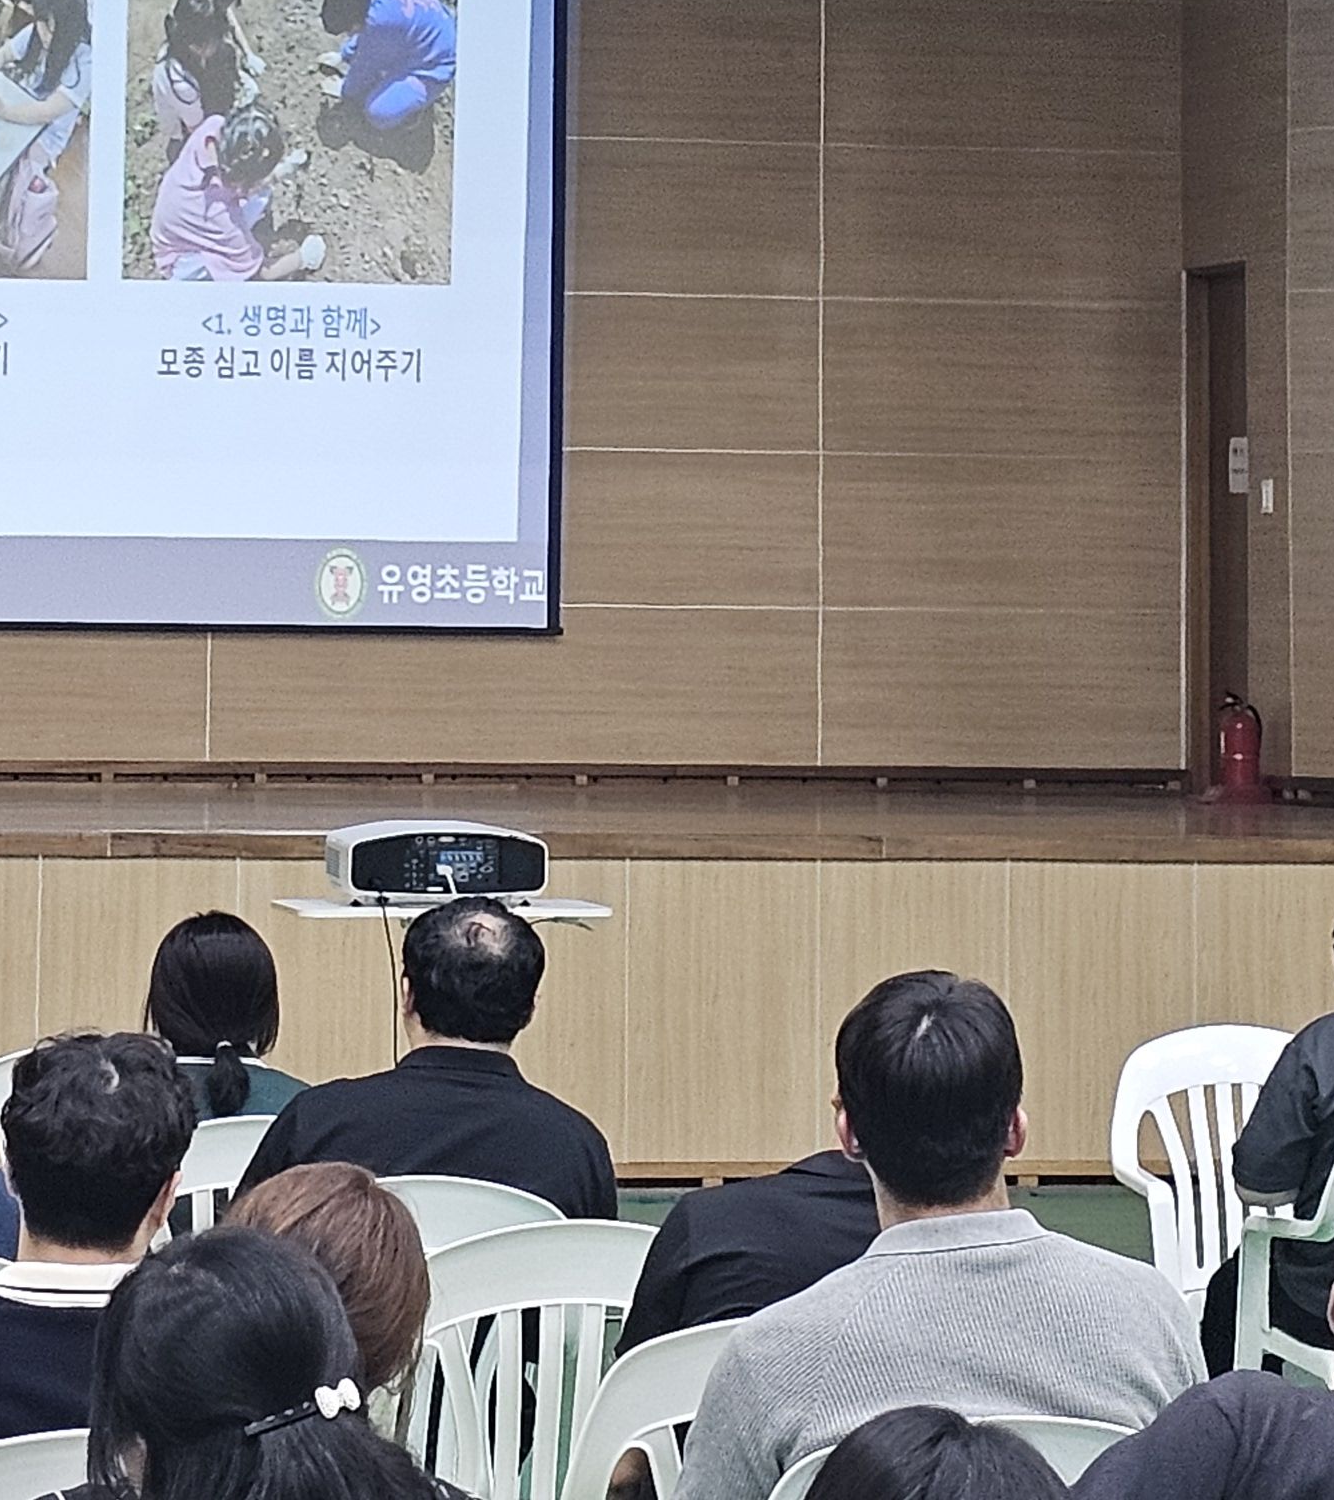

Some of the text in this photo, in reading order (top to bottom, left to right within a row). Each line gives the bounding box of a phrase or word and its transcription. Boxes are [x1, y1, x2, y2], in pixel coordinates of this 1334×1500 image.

[201, 304, 382, 341] <1. 생명과 함께>
[156, 346, 422, 383] 모종 심고 이름 지어주기
[377, 563, 548, 605] 유영초등학교
